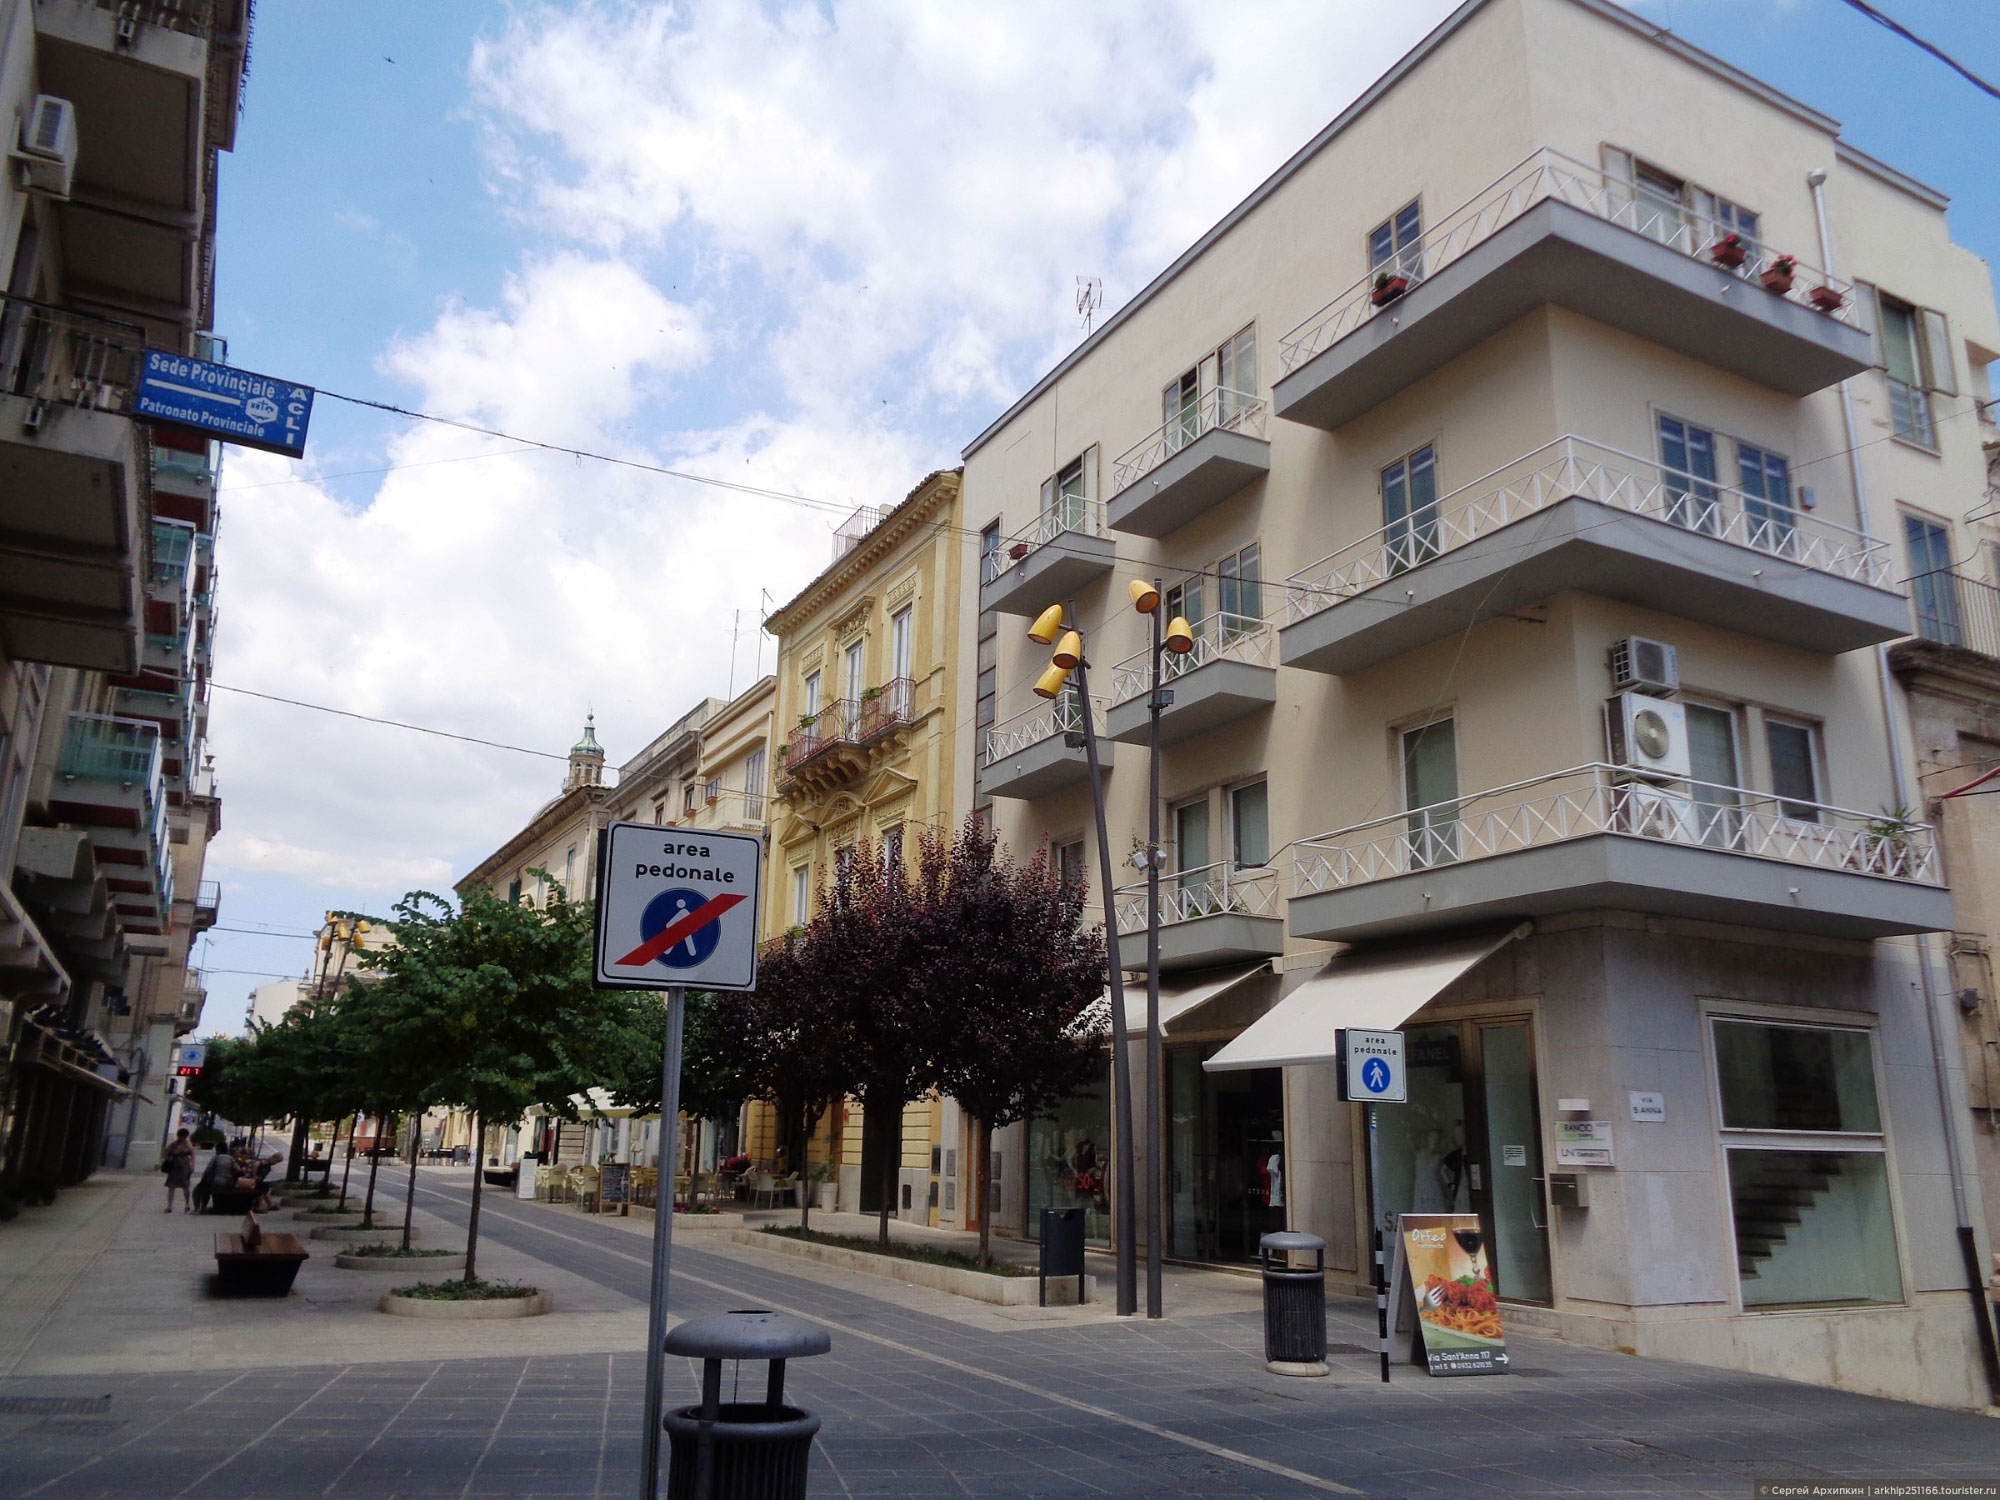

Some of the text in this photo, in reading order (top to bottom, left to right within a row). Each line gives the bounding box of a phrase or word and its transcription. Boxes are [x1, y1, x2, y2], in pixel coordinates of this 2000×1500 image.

[150, 353, 275, 399] Sede Provinciale
[140, 397, 265, 437] Patronato Provinciale
[664, 843, 710, 858] area
[636, 863, 735, 883] pedonale
[1354, 1046, 1397, 1055] pedonale
[1428, 1351, 1490, 1361] Via Sant'Anna 117
